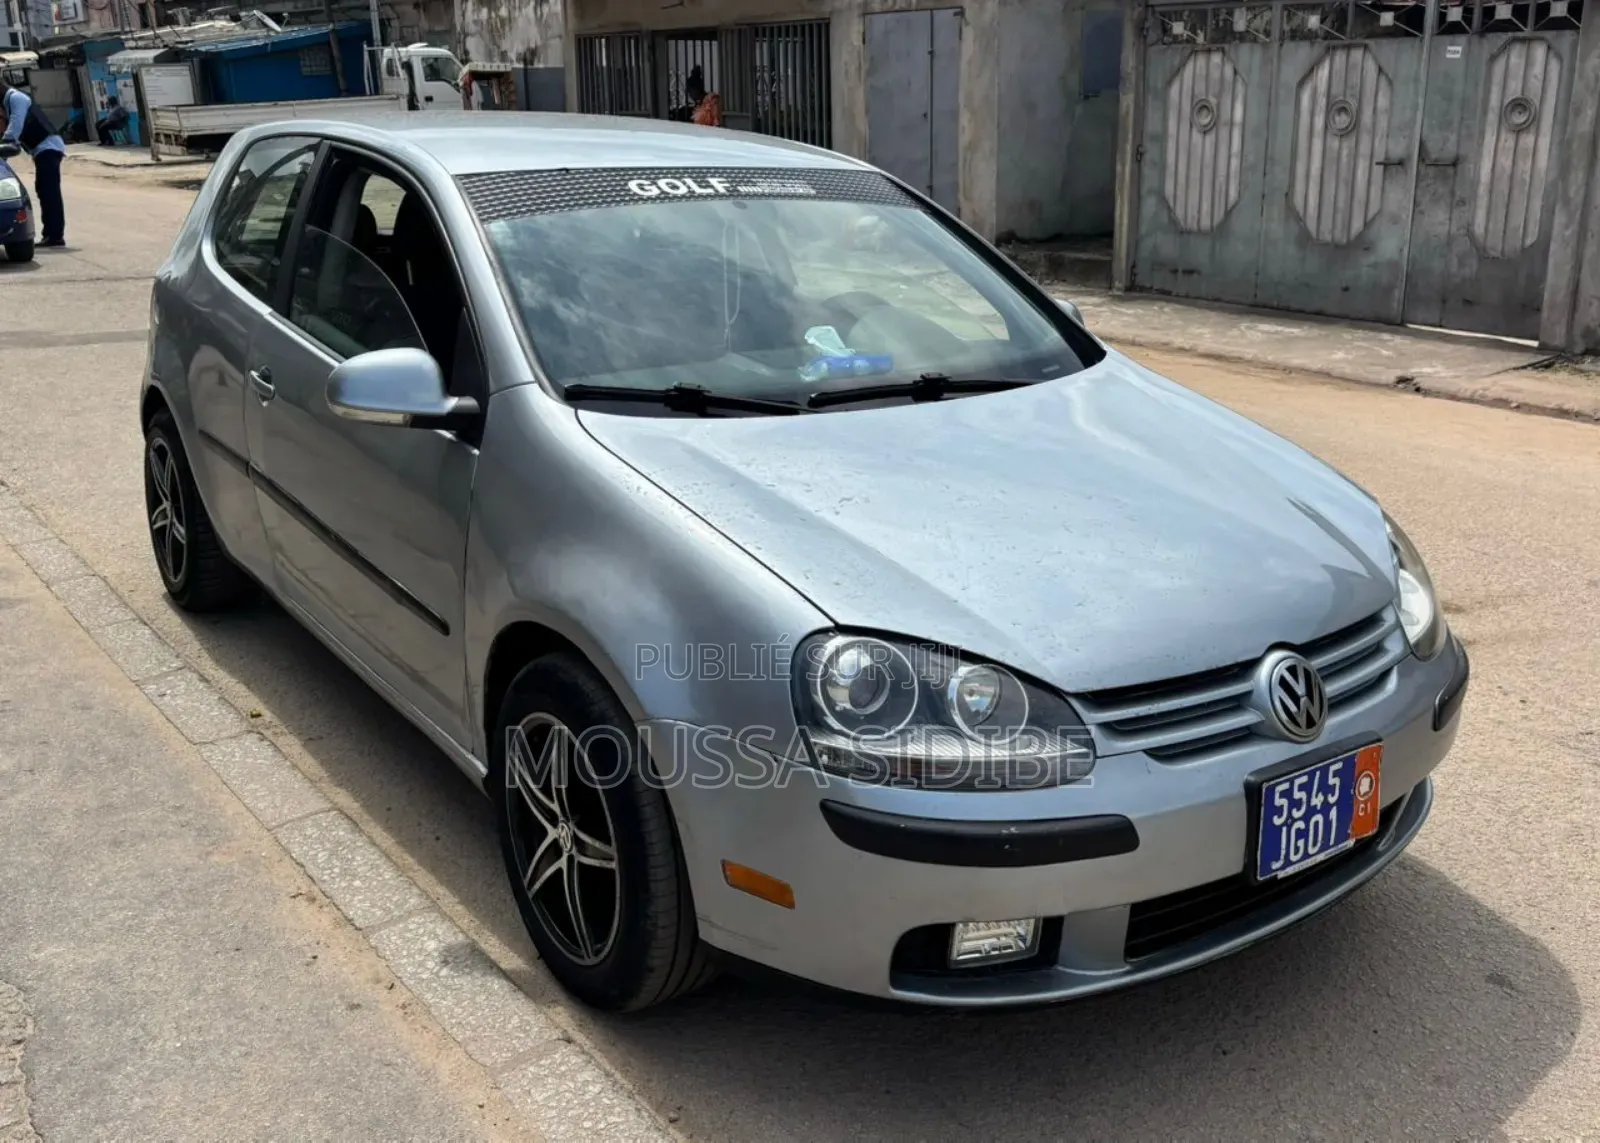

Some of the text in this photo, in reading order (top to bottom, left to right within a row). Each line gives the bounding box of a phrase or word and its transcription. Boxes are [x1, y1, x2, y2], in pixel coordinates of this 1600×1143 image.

[627, 177, 730, 196] GOLF
[1272, 761, 1343, 826] 5545
[1271, 805, 1337, 870] JG01
